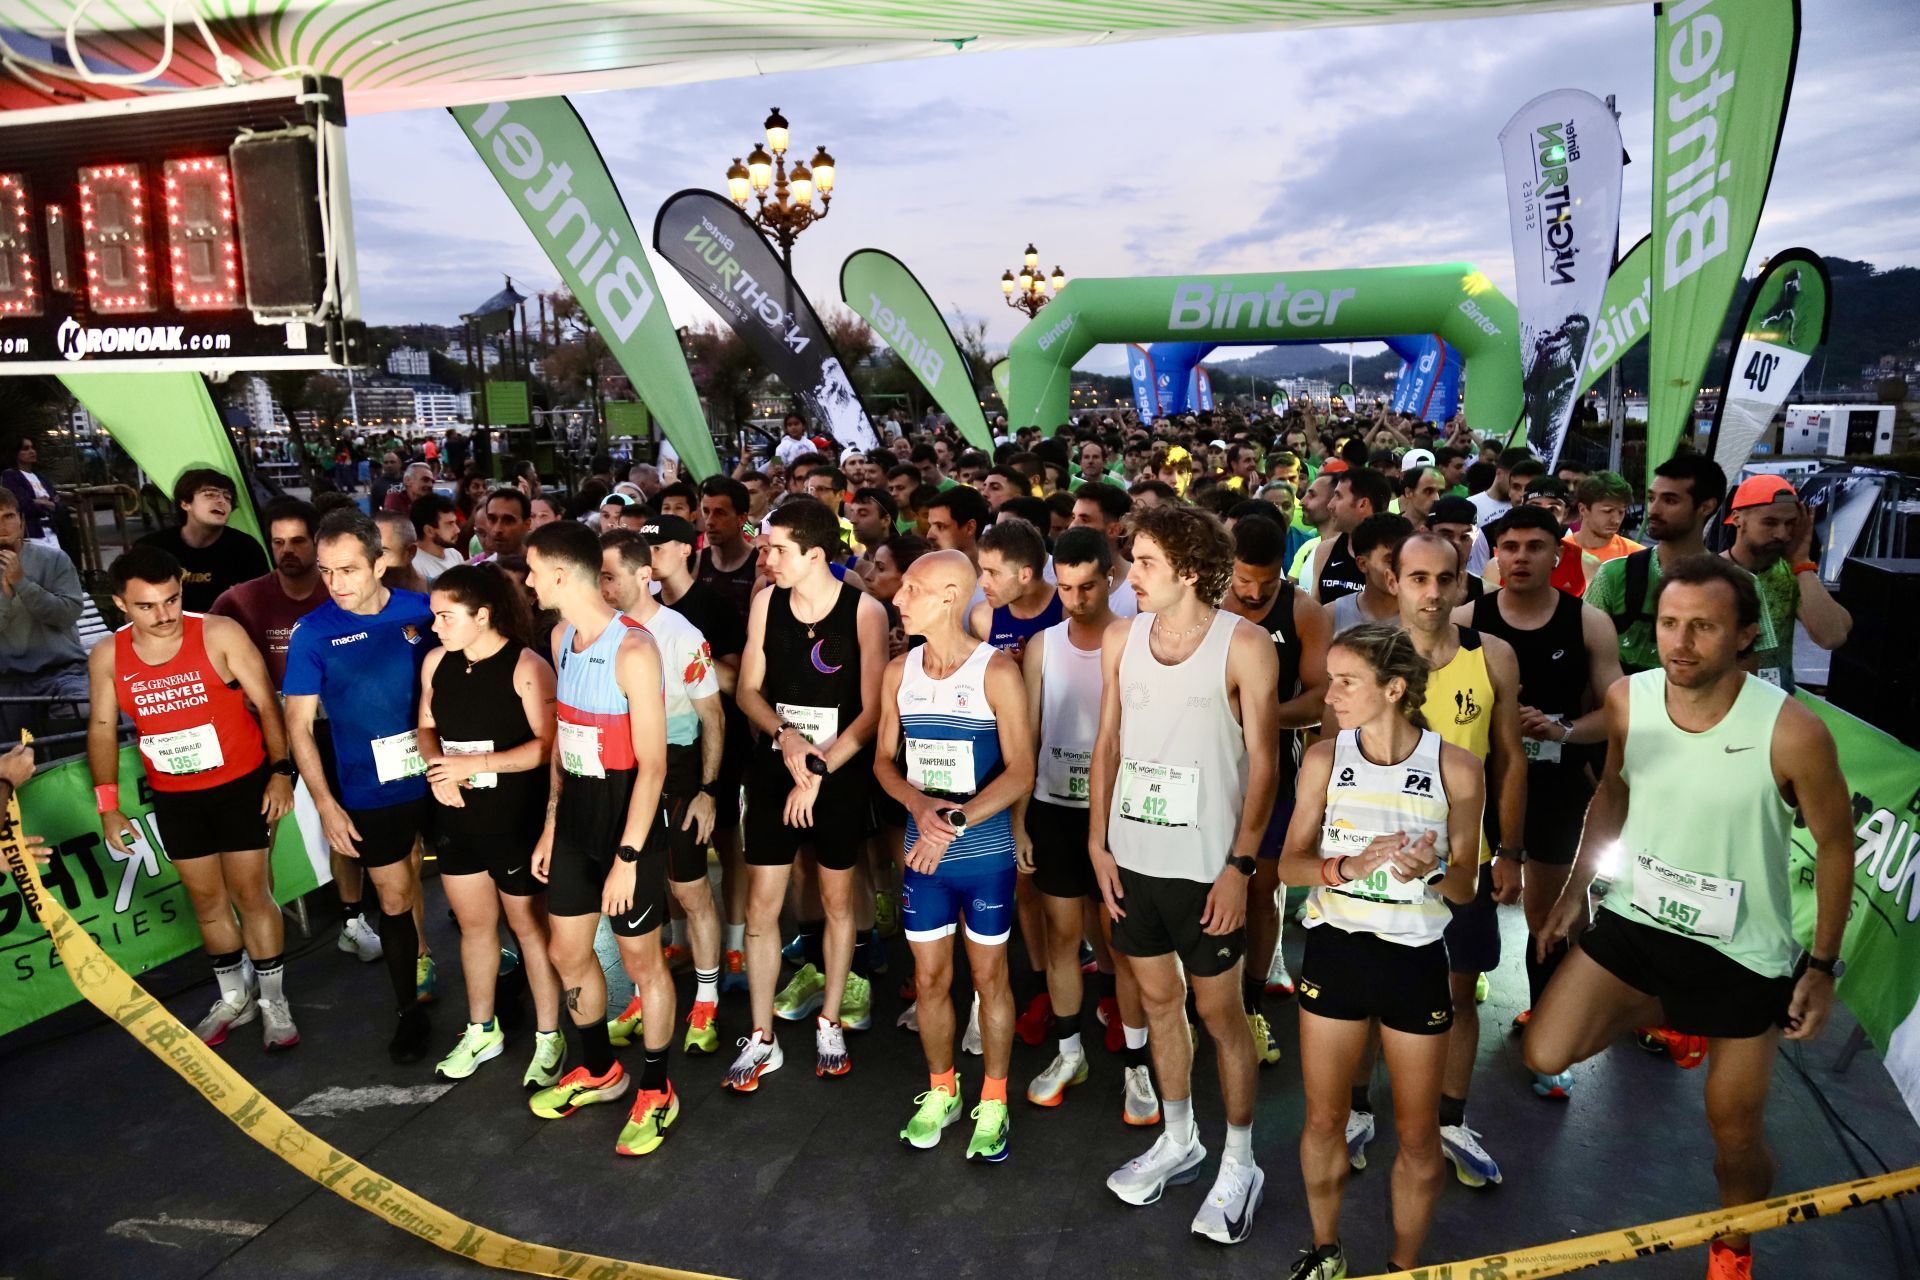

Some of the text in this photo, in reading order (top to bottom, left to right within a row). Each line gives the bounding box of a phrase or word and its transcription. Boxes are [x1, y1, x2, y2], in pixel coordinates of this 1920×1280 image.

[1168, 282, 1356, 330] Binter
[1458, 298, 1501, 336] Binter
[1037, 312, 1074, 352] Binter
[1322, 579, 1366, 592] TOP4RUN
[331, 632, 368, 646] macron
[147, 670, 201, 690] GENERALI
[134, 685, 191, 706] GENÈVE
[138, 694, 208, 717] MARATHON
[922, 769, 952, 788] 1295
[1150, 783, 1162, 793] AVE
[1405, 774, 1431, 792] PA
[1142, 796, 1168, 817] 412
[1638, 855, 1654, 870] 10K
[2, 842, 43, 914] EVENTOS
[1658, 896, 1702, 926] 1457
